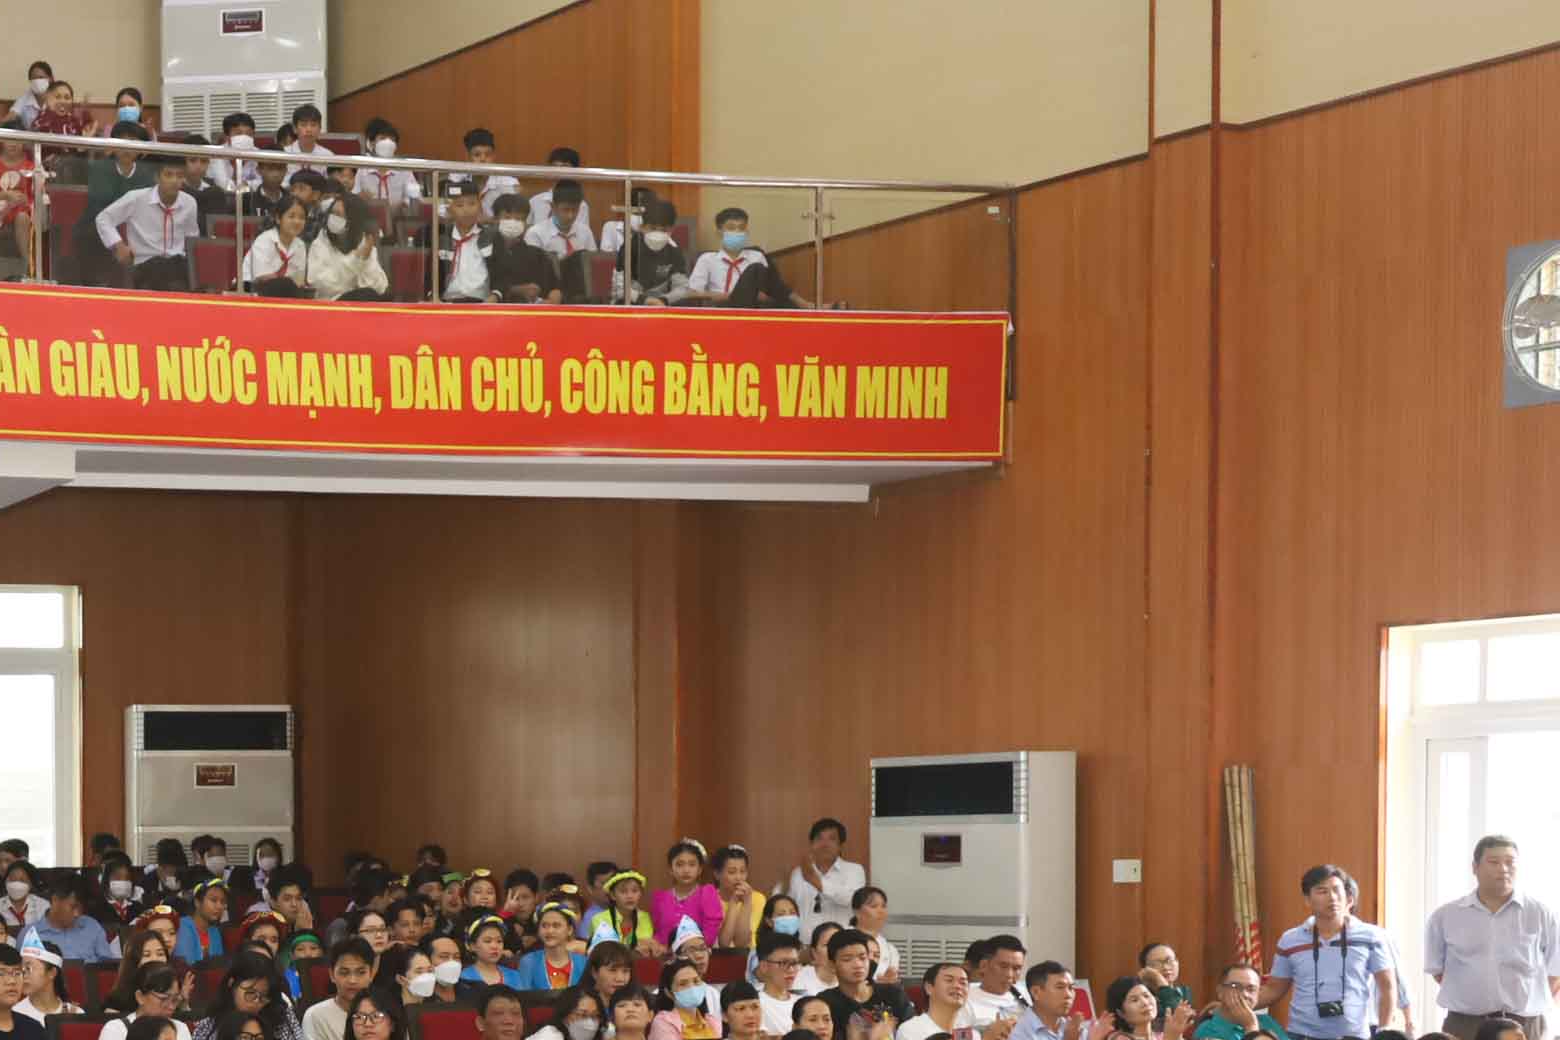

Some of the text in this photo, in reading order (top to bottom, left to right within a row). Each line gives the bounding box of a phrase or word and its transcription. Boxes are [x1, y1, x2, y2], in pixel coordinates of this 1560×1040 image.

[50, 330, 151, 405] GIÀU,
[156, 336, 258, 405] NƯỚC
[267, 351, 383, 419] MẠNH,
[390, 345, 463, 410] DÂN
[471, 342, 553, 419] CHỦ,
[559, 348, 656, 416] CÔNG
[663, 343, 768, 422] BẰNG,
[775, 355, 848, 418] VĂN
[855, 365, 950, 419] MINH
